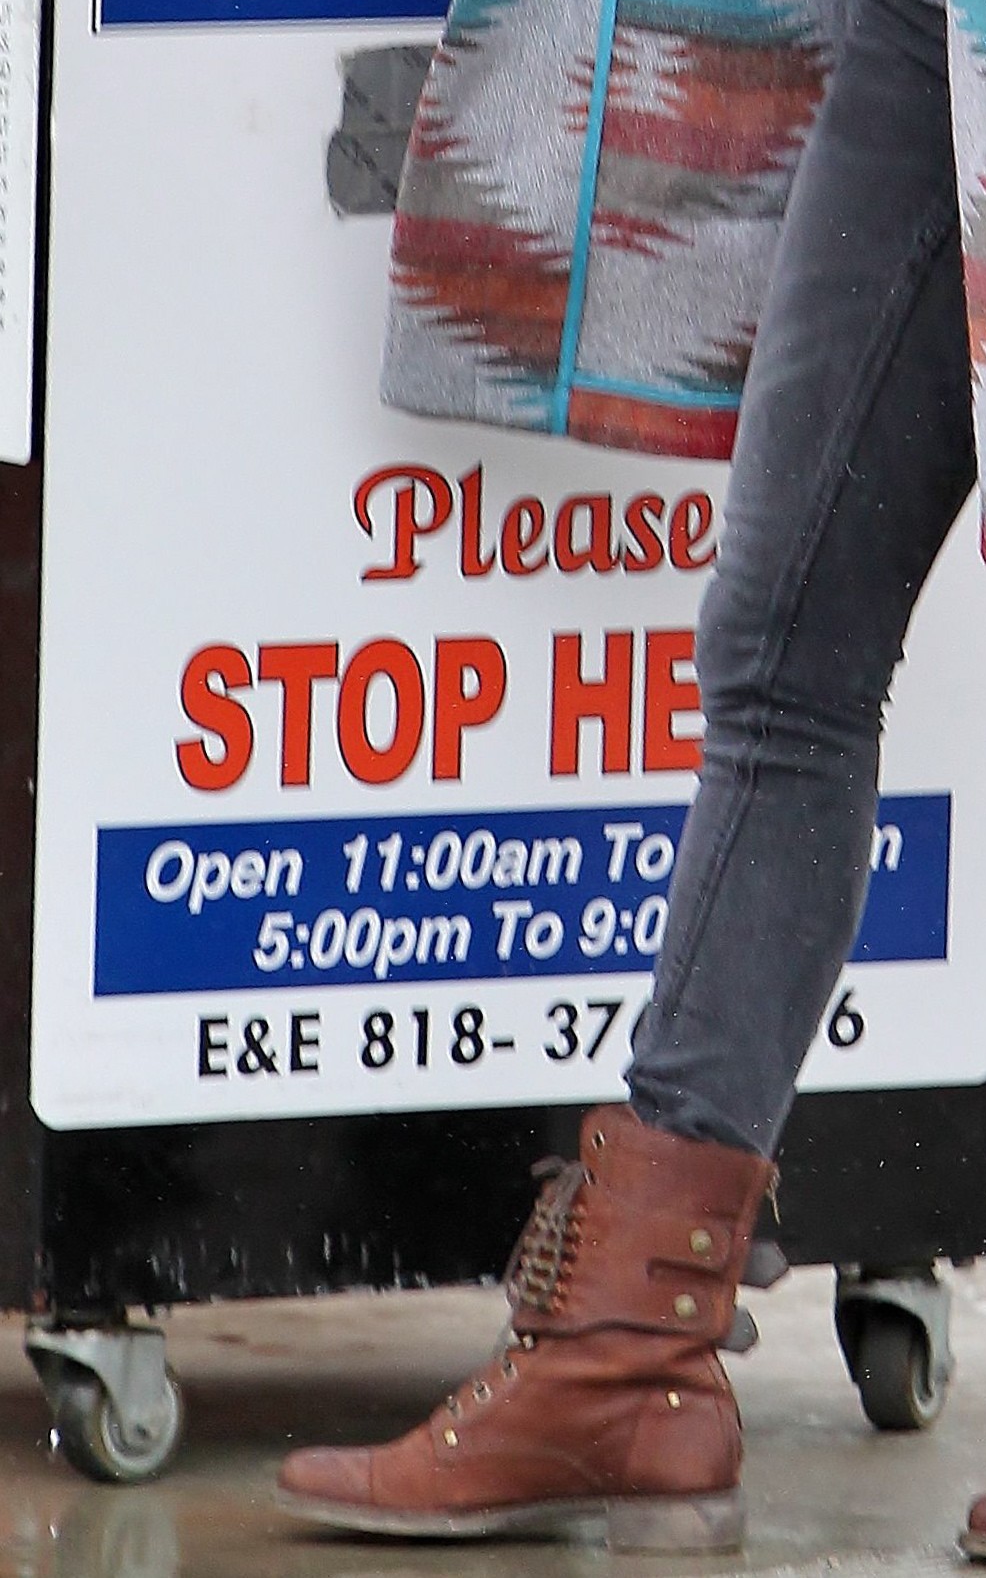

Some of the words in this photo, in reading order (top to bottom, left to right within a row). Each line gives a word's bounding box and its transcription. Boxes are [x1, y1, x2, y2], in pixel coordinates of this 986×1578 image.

[354, 462, 718, 584] Please
[176, 638, 507, 791] STOP
[551, 631, 704, 777] HE
[144, 839, 303, 915] Open
[341, 828, 583, 894] 11:00am
[602, 822, 676, 883] To
[252, 906, 472, 979] 5:00pm
[492, 898, 565, 960] To
[198, 1014, 322, 1078] E&E
[360, 1006, 516, 1070] 818-
